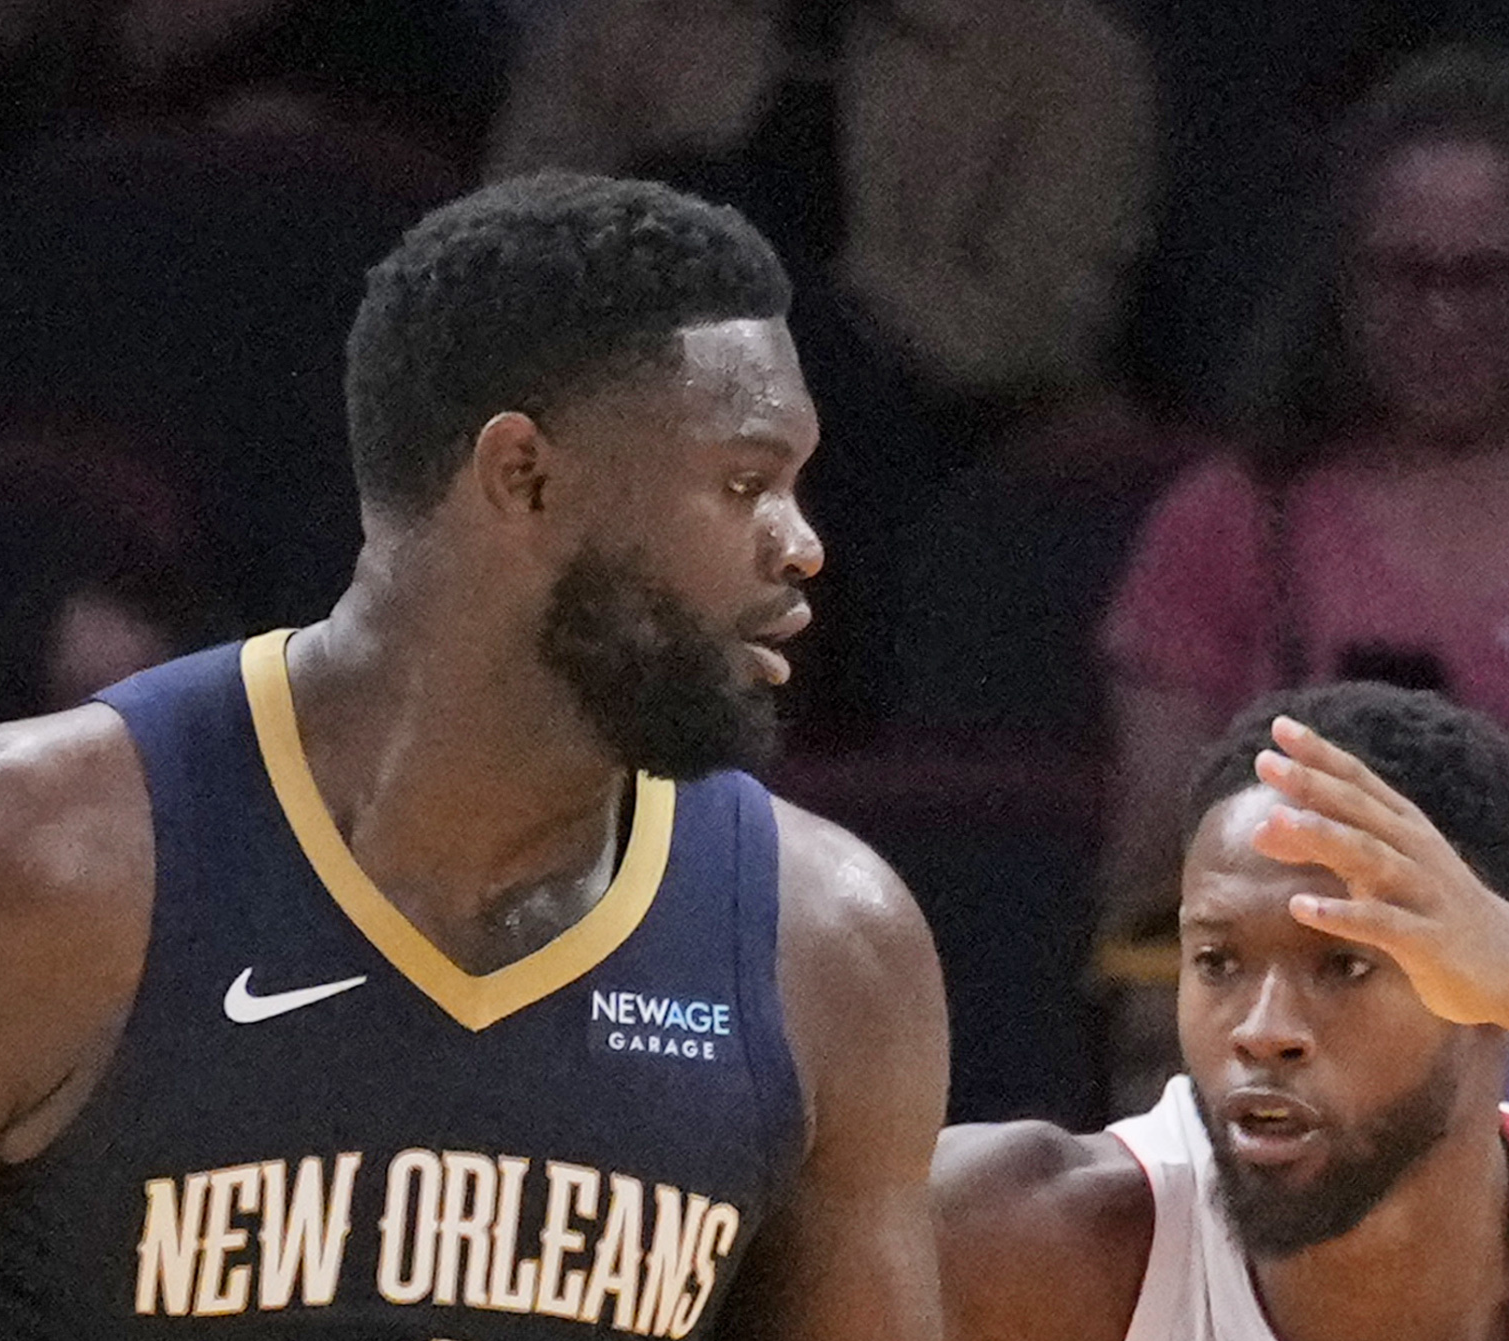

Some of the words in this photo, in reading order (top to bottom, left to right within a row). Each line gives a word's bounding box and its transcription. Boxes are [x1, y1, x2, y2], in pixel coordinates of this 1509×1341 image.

[608, 1032, 715, 1060] GARAGE
[135, 1151, 363, 1317] NEW
[377, 1147, 740, 1341] ORLEANS
